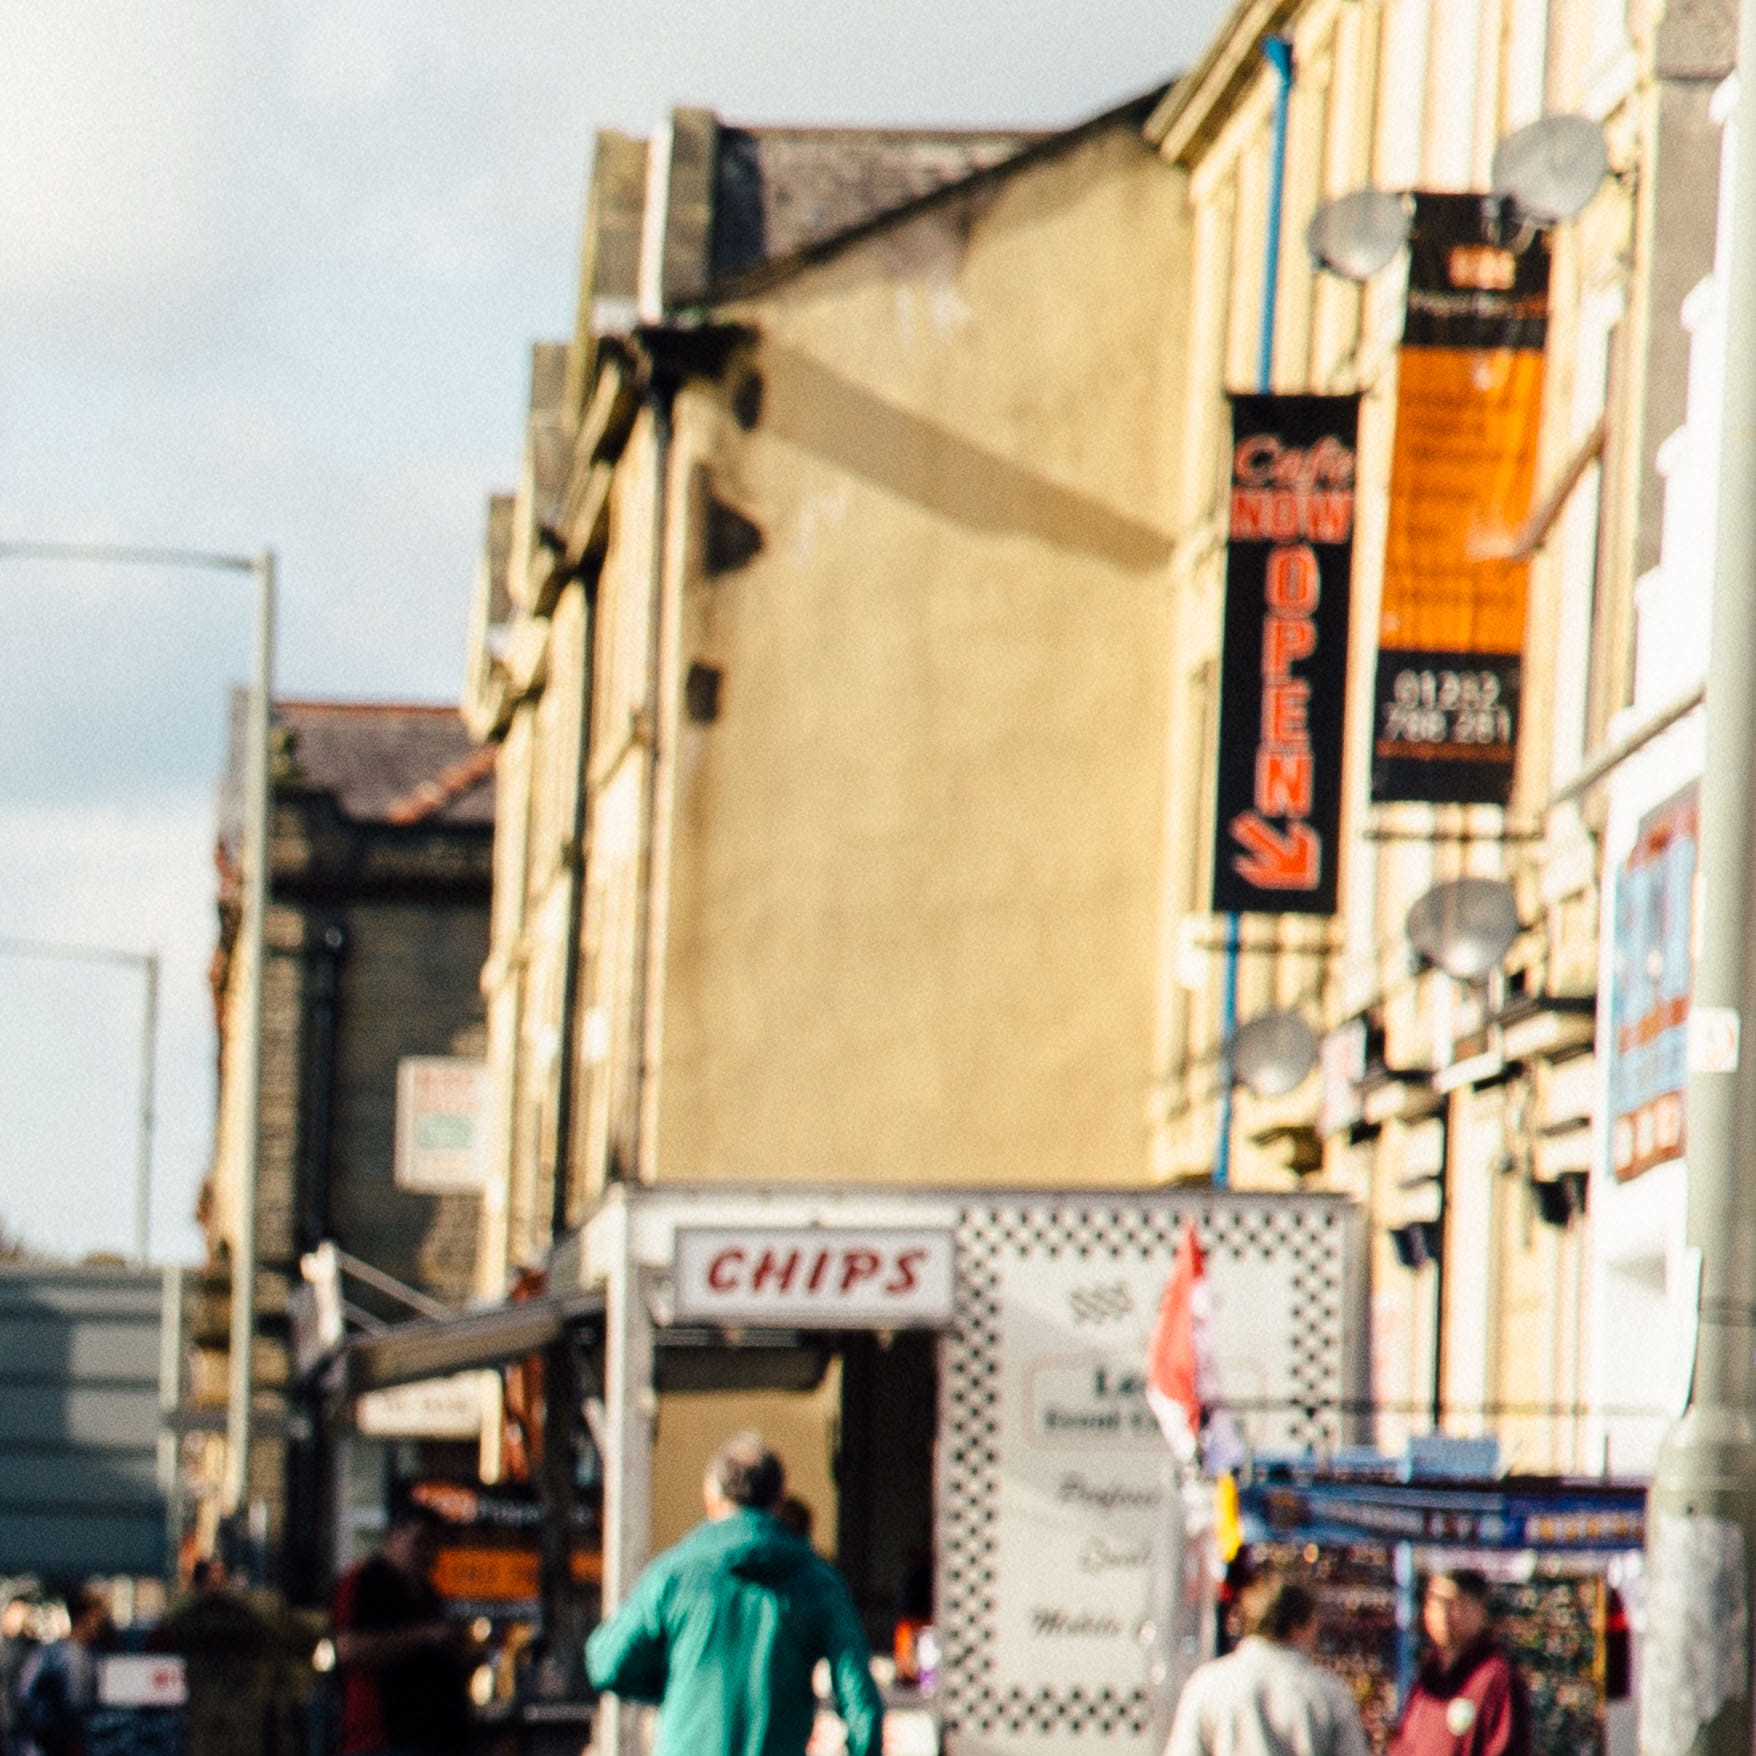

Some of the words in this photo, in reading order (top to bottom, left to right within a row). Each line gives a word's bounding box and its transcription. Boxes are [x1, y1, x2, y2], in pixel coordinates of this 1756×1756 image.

[1231, 488, 1353, 541] NOW
[1254, 542, 1321, 818] OPEN
[707, 1248, 927, 1292] CHIPS
